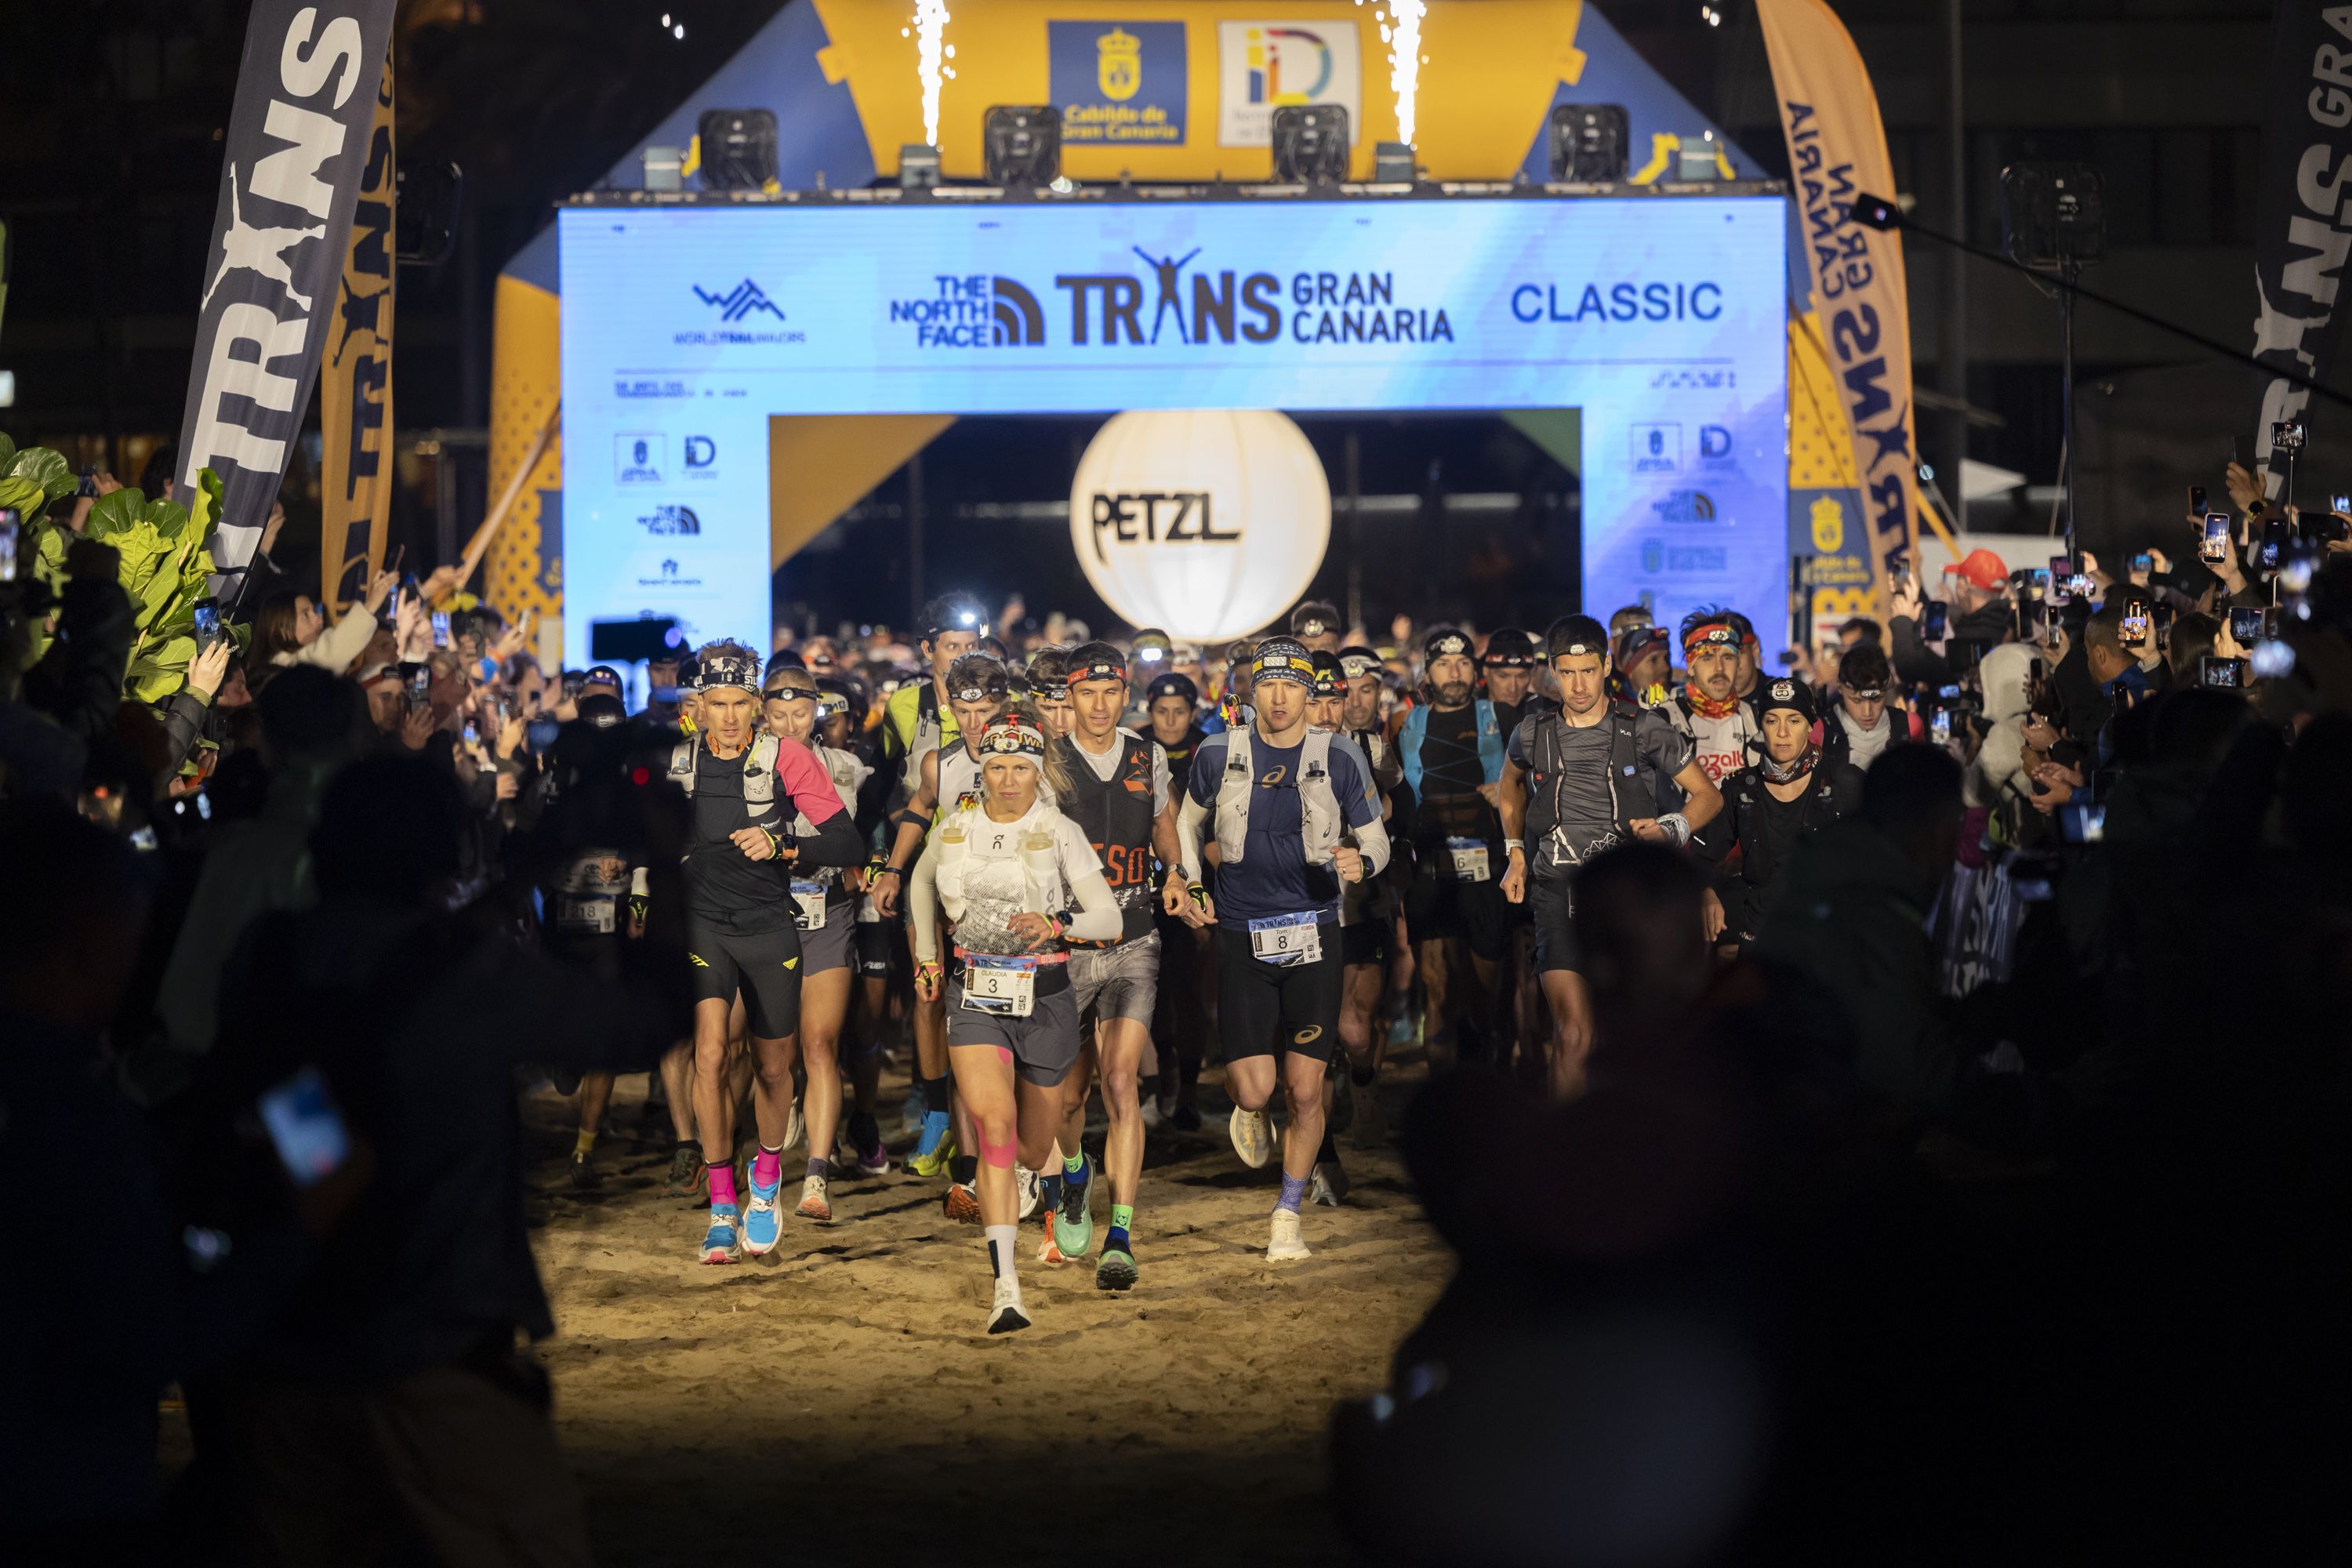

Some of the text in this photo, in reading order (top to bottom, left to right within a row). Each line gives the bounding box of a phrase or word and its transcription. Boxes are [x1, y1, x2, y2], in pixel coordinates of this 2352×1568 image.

[935, 275, 987, 298] THE
[1054, 245, 1282, 347] TRANS
[1292, 271, 1392, 306] GRAN
[891, 300, 988, 323] NORTH
[1511, 282, 1722, 323] CLASSIC
[919, 325, 988, 348] FACE
[1292, 307, 1456, 344] CANARIA
[1093, 492, 1241, 566] PETZL
[1278, 935, 1287, 949] 8
[981, 969, 1007, 978] CLAUDIA
[988, 978, 998, 993] 3
